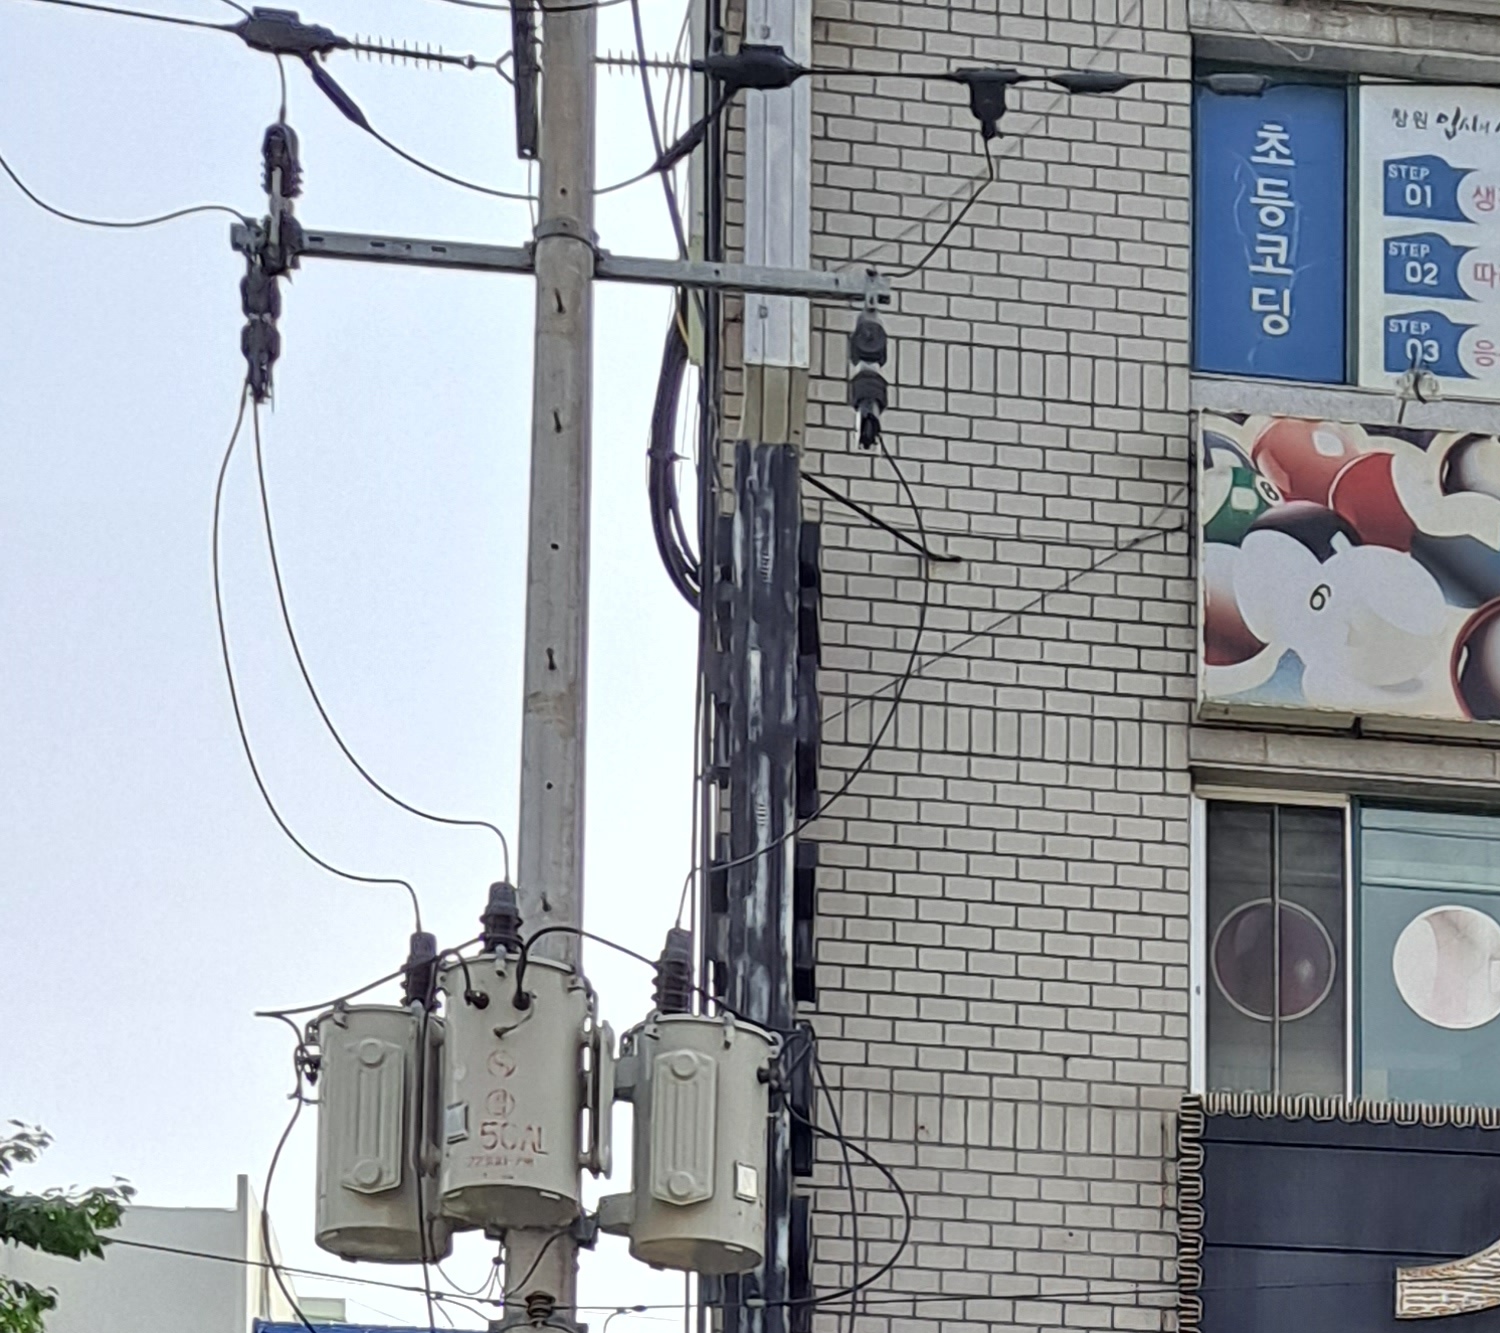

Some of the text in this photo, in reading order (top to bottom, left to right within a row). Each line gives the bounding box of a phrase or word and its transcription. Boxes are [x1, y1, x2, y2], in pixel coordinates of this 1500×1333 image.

[1387, 164, 1430, 181] STEP
[1404, 184, 1432, 208] 01
[1249, 121, 1296, 338] 초등코딩
[1388, 242, 1430, 257] STEP
[1405, 262, 1439, 286] 02
[1388, 319, 1431, 335] STEP
[1406, 338, 1439, 364] 03
